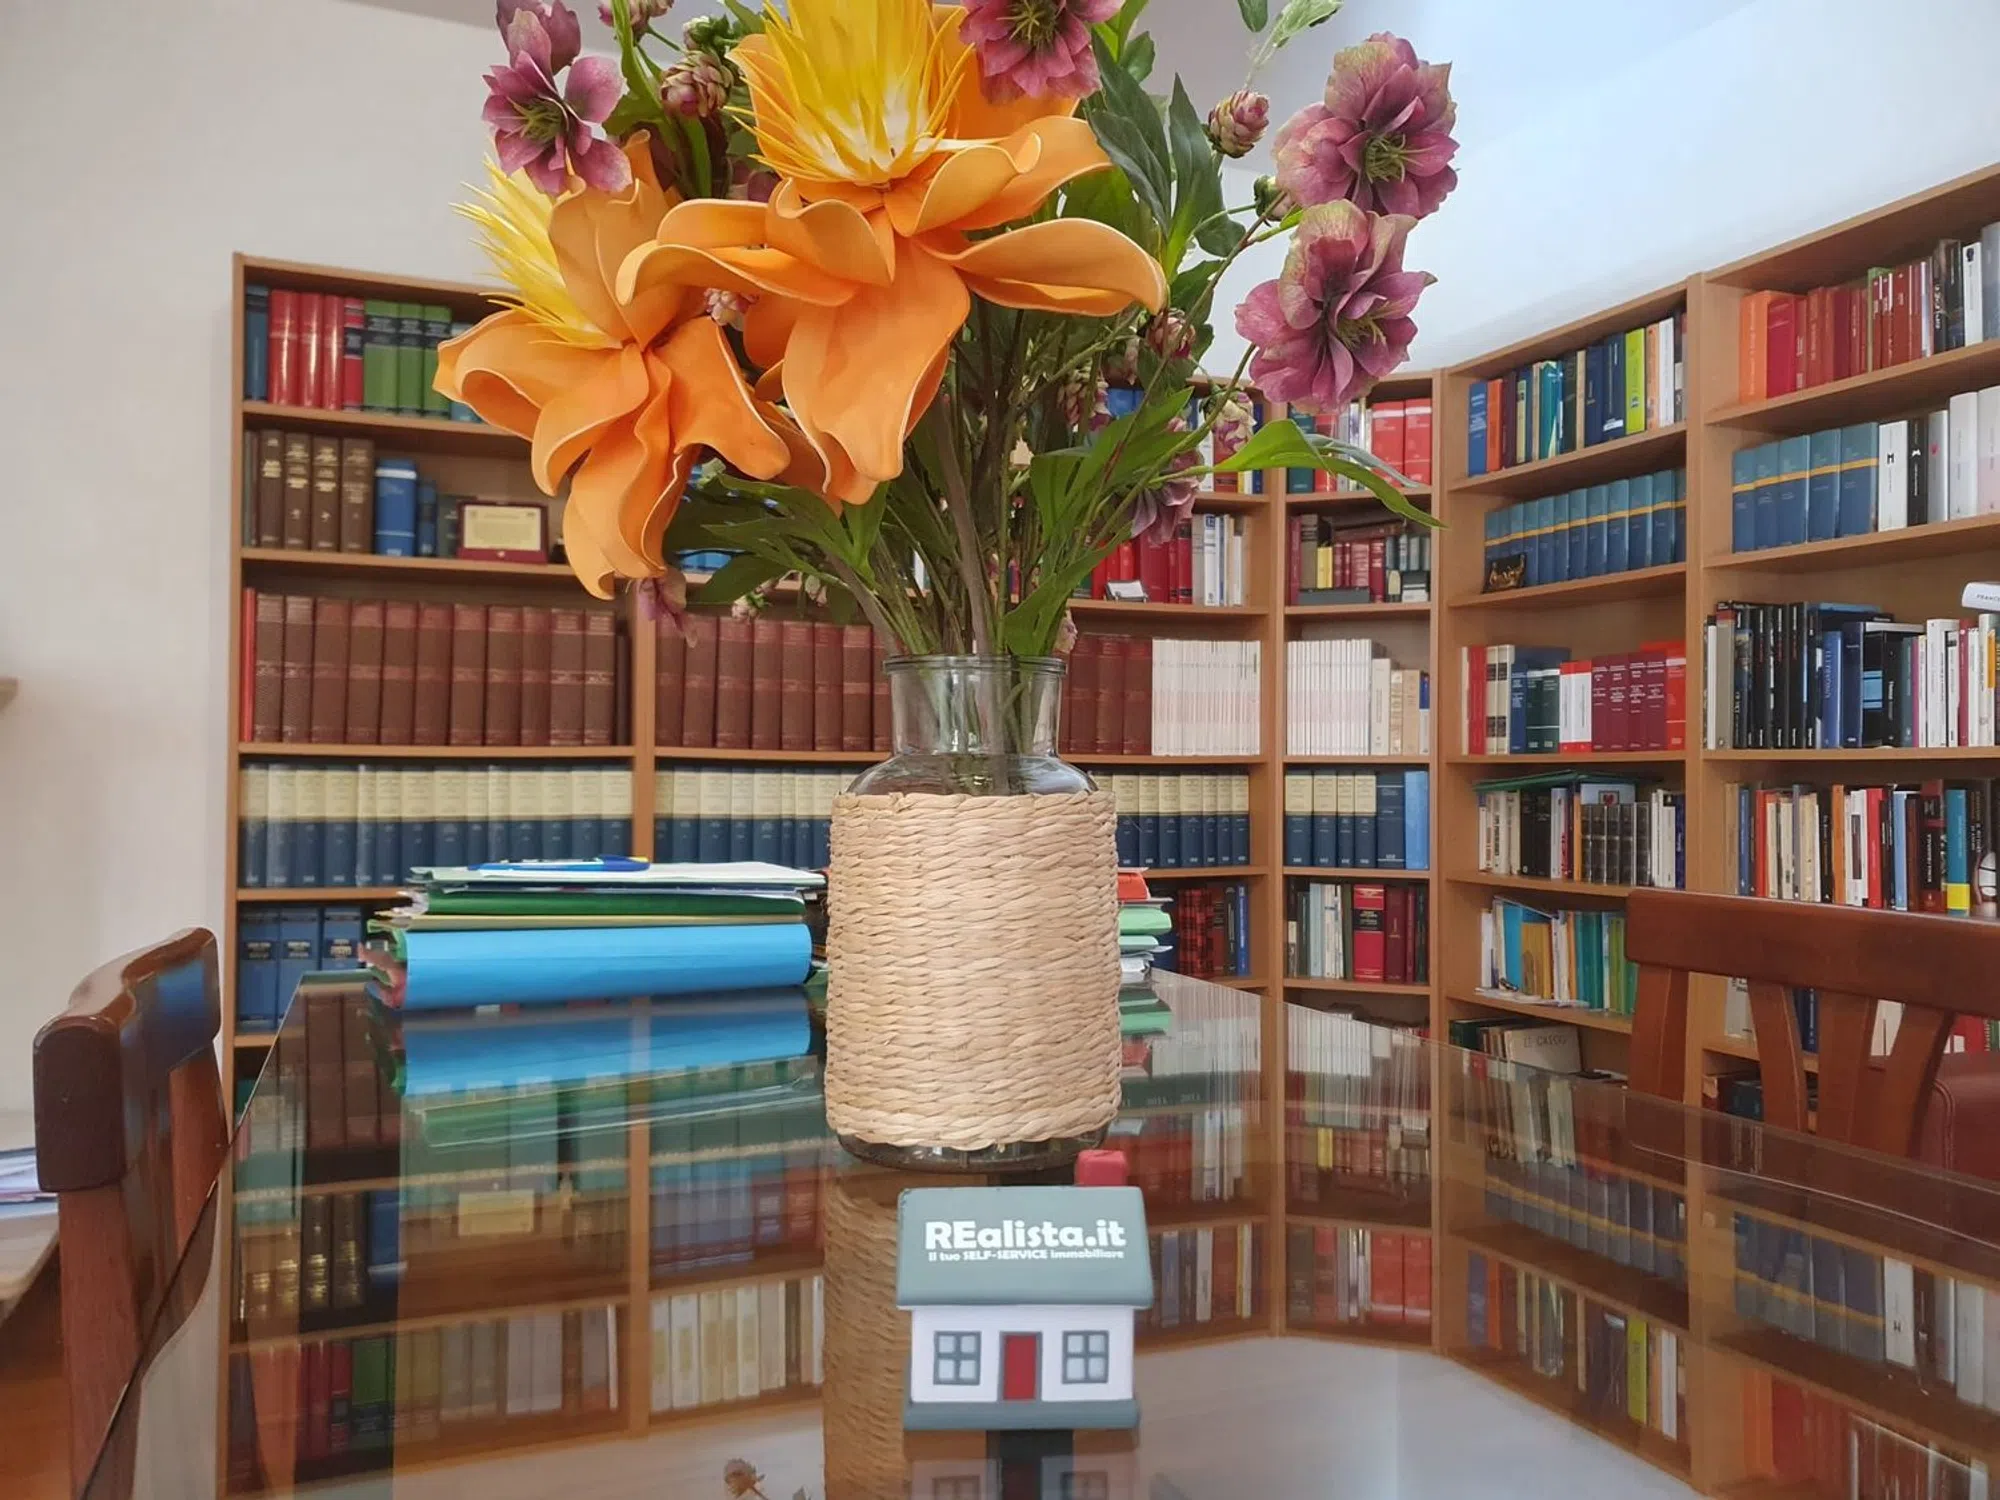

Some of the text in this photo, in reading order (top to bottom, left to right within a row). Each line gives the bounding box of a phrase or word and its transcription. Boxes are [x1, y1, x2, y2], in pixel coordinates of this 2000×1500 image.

[925, 1219, 1126, 1250] REalista.it
[928, 1249, 1125, 1262] Il tuo SELF-SERVICE immobiliare
